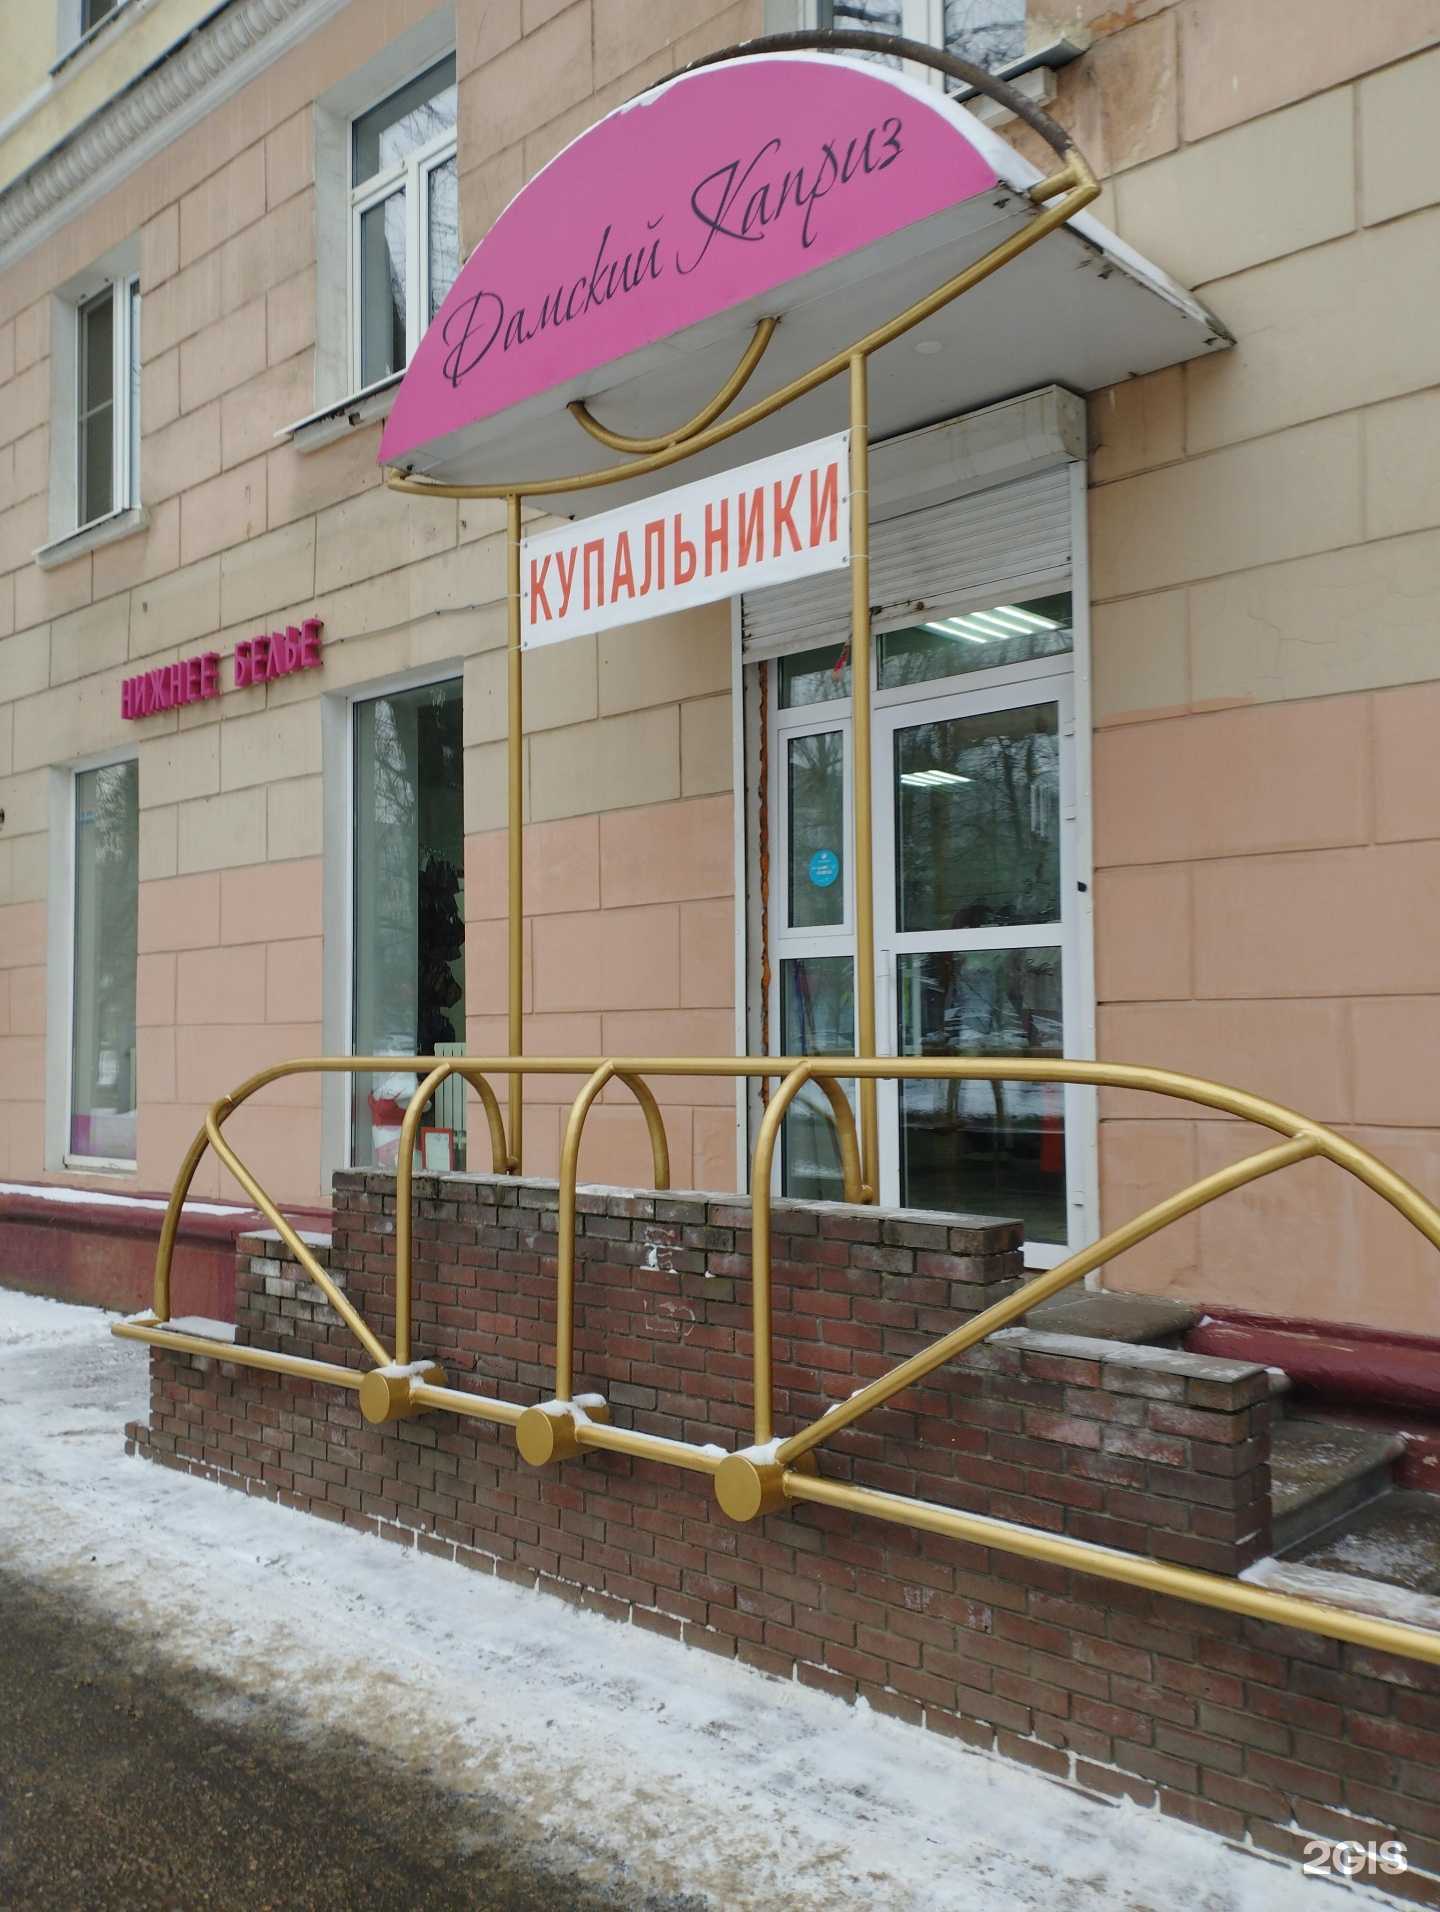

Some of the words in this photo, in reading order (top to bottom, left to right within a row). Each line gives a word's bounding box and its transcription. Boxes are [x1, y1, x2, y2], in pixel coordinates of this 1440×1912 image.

[442, 214, 662, 388] Дамский
[676, 117, 903, 274] Каприз
[530, 462, 838, 625] КУПАЛЬНИКИ
[121, 651, 221, 720] НИЖНЕЕ
[234, 618, 324, 688] БЕЛЬЕ
